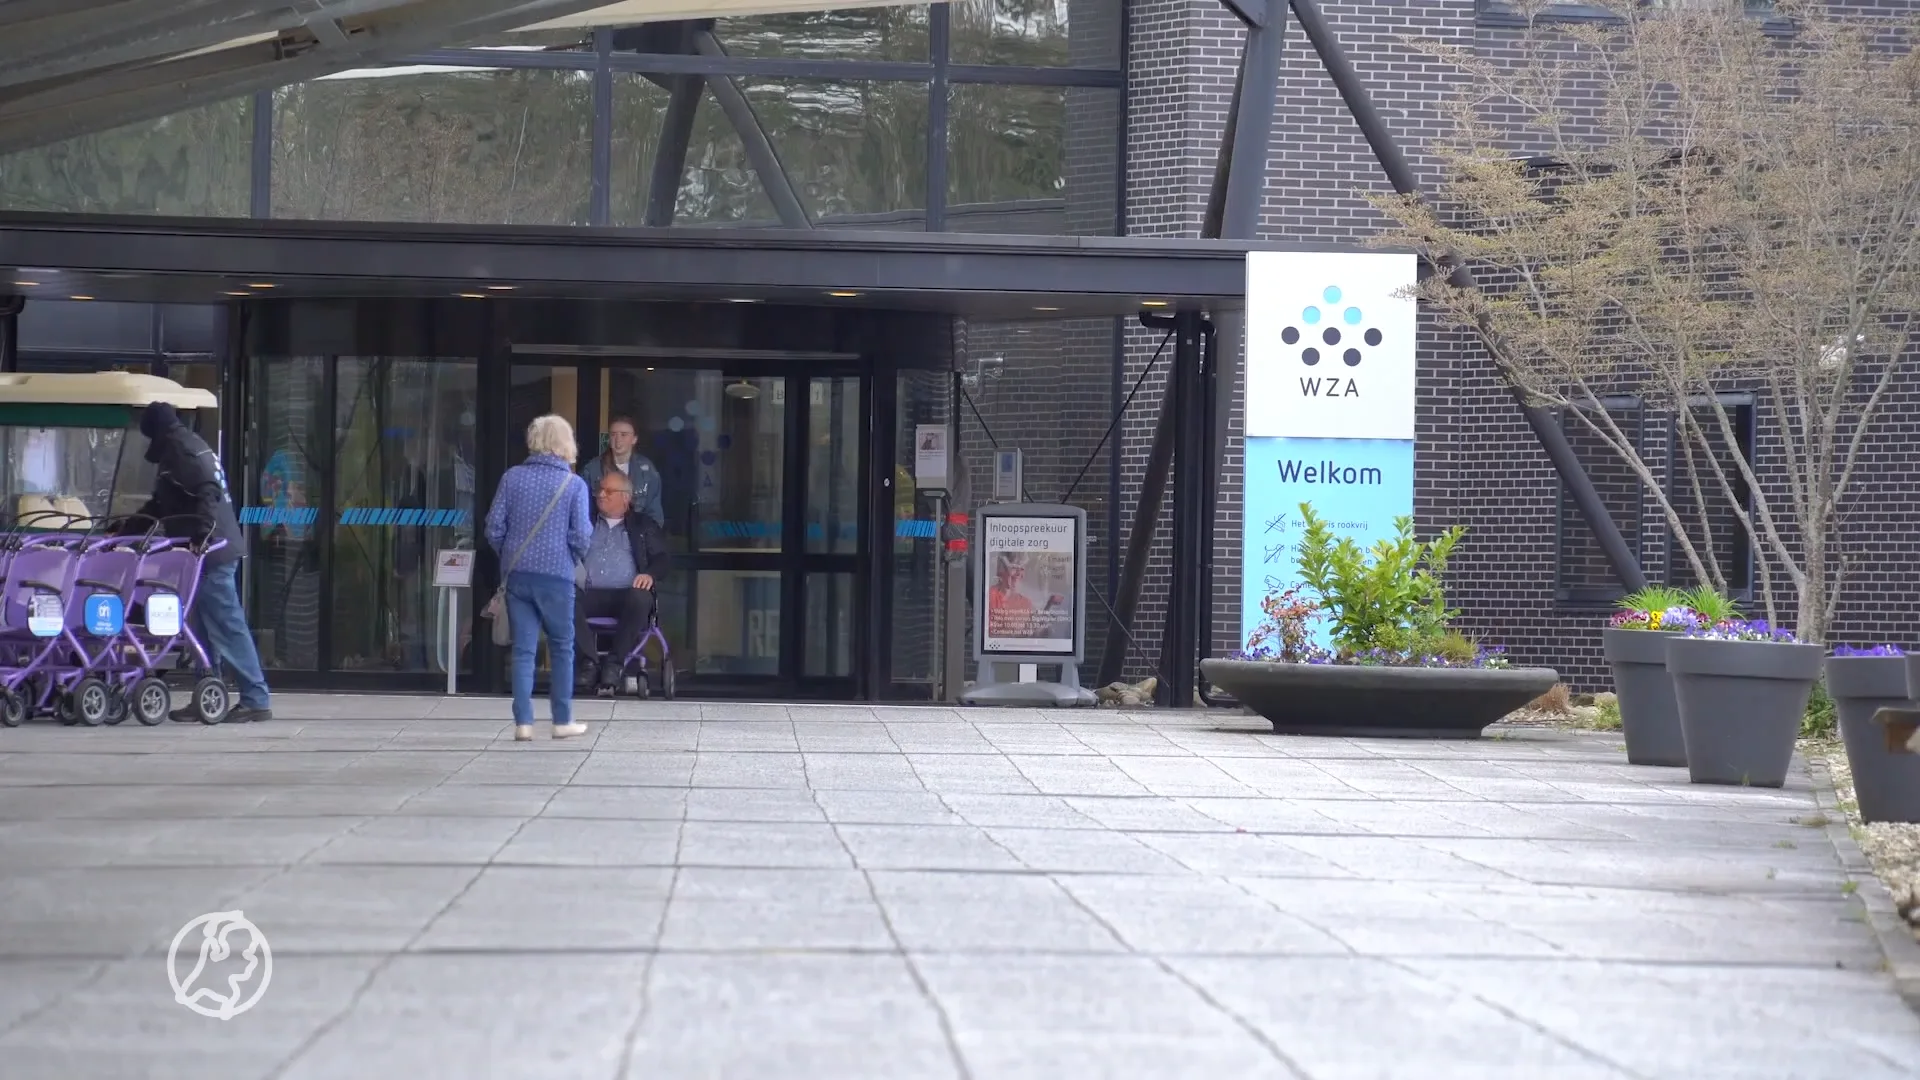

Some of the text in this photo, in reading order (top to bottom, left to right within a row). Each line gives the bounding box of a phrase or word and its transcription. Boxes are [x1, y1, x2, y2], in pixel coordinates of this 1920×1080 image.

[1300, 377, 1359, 397] WZA
[1278, 460, 1381, 485] Welkom
[990, 523, 1068, 534] Inloopspreekuur
[1291, 520, 1368, 531] Het is rookvrij
[990, 537, 1049, 549] digitale zorg
